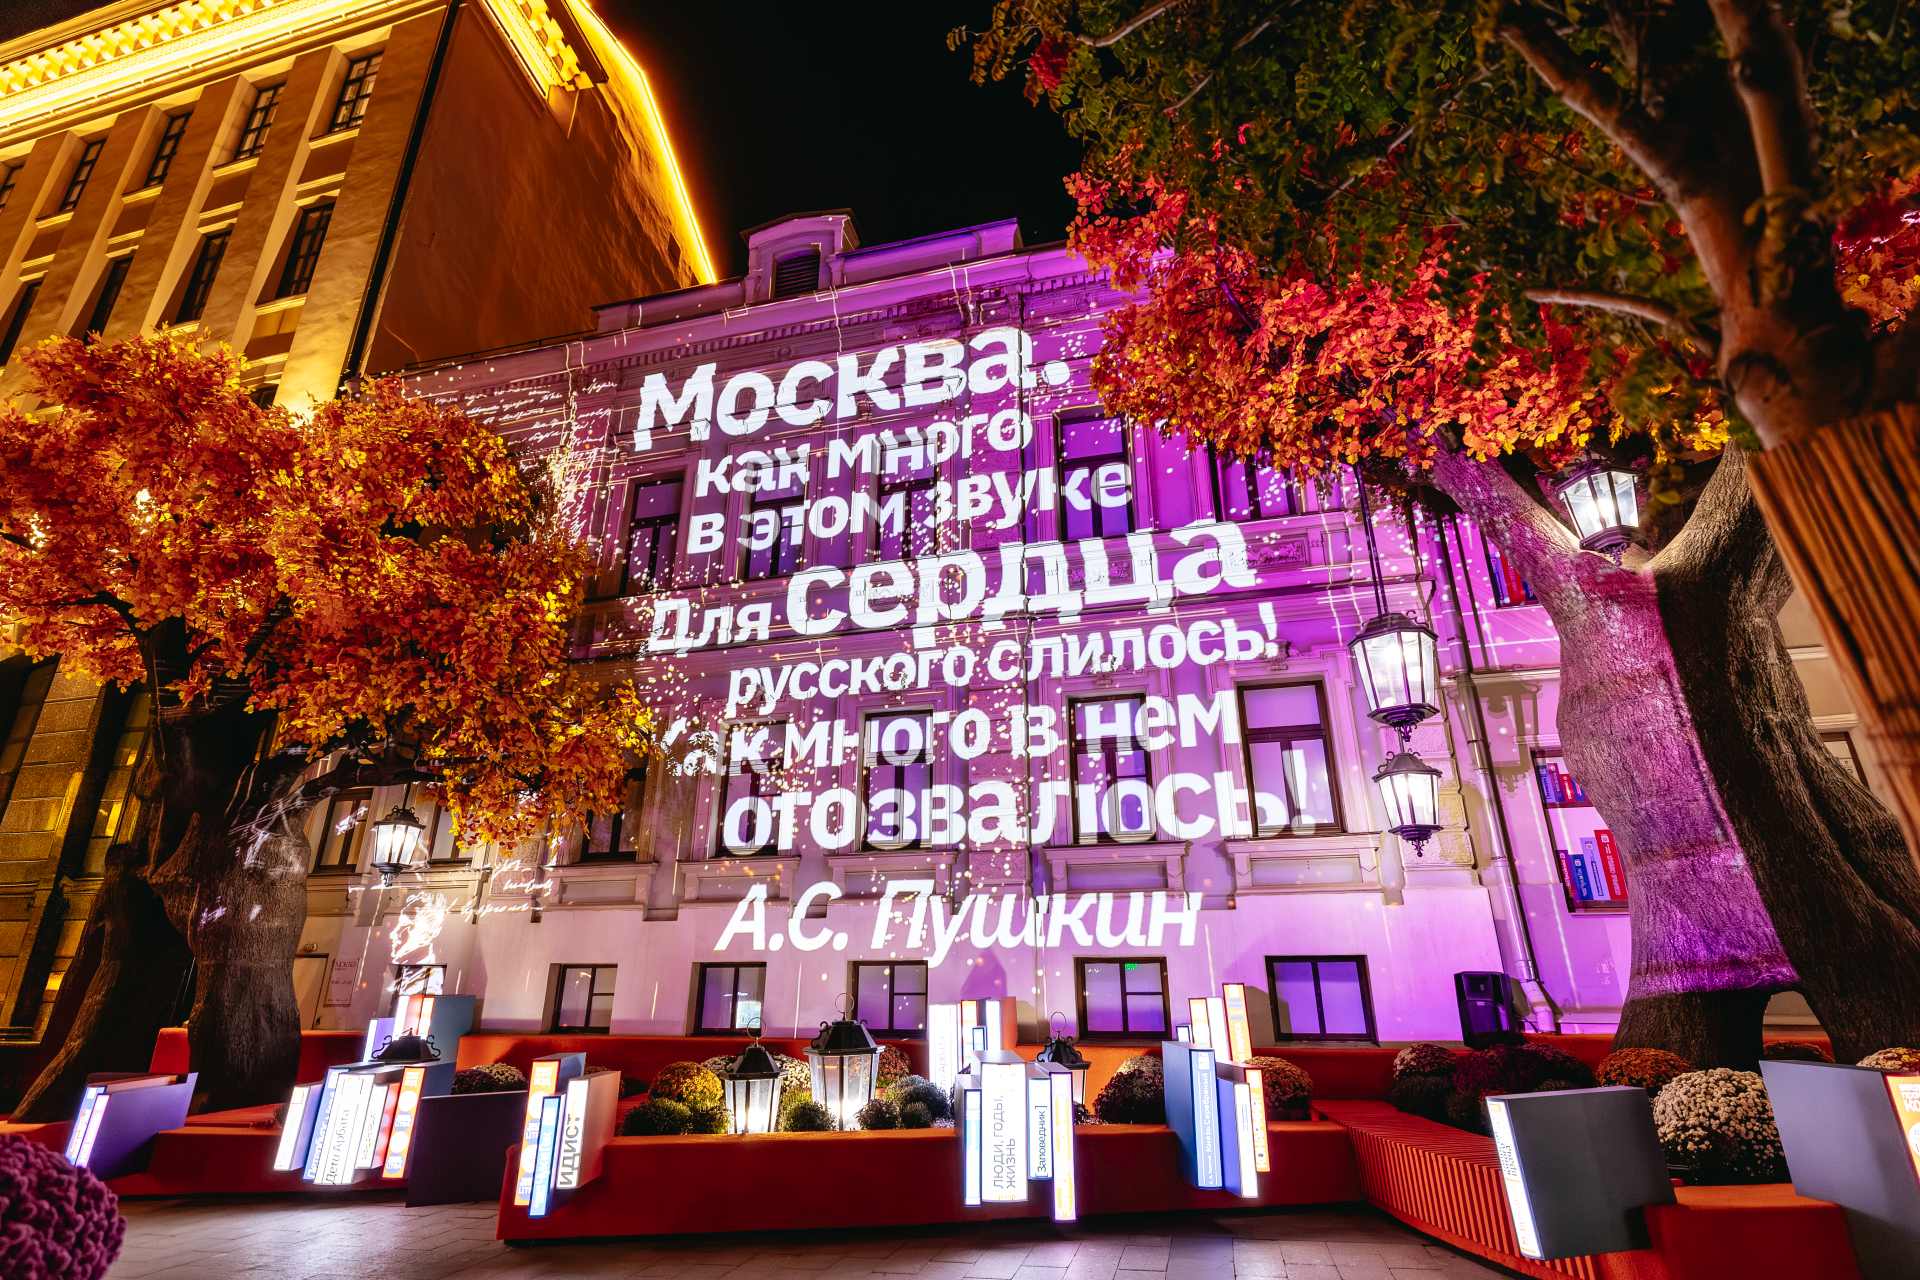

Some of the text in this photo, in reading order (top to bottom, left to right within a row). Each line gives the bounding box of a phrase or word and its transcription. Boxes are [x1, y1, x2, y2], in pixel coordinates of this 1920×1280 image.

[634, 326, 1071, 452] Москва.
[695, 408, 1034, 498] как много
[686, 460, 1133, 554] в этом звуке
[646, 518, 1257, 657] Для сердца
[725, 602, 1279, 719] русского слилось!
[783, 706, 995, 768] много
[1011, 706, 1059, 758] в
[1085, 690, 1242, 760] нем
[722, 748, 1317, 855] отозвалось!
[868, 879, 1203, 969] Пушкин
[1005, 1138, 1016, 1190] ЖИЗНЬ
